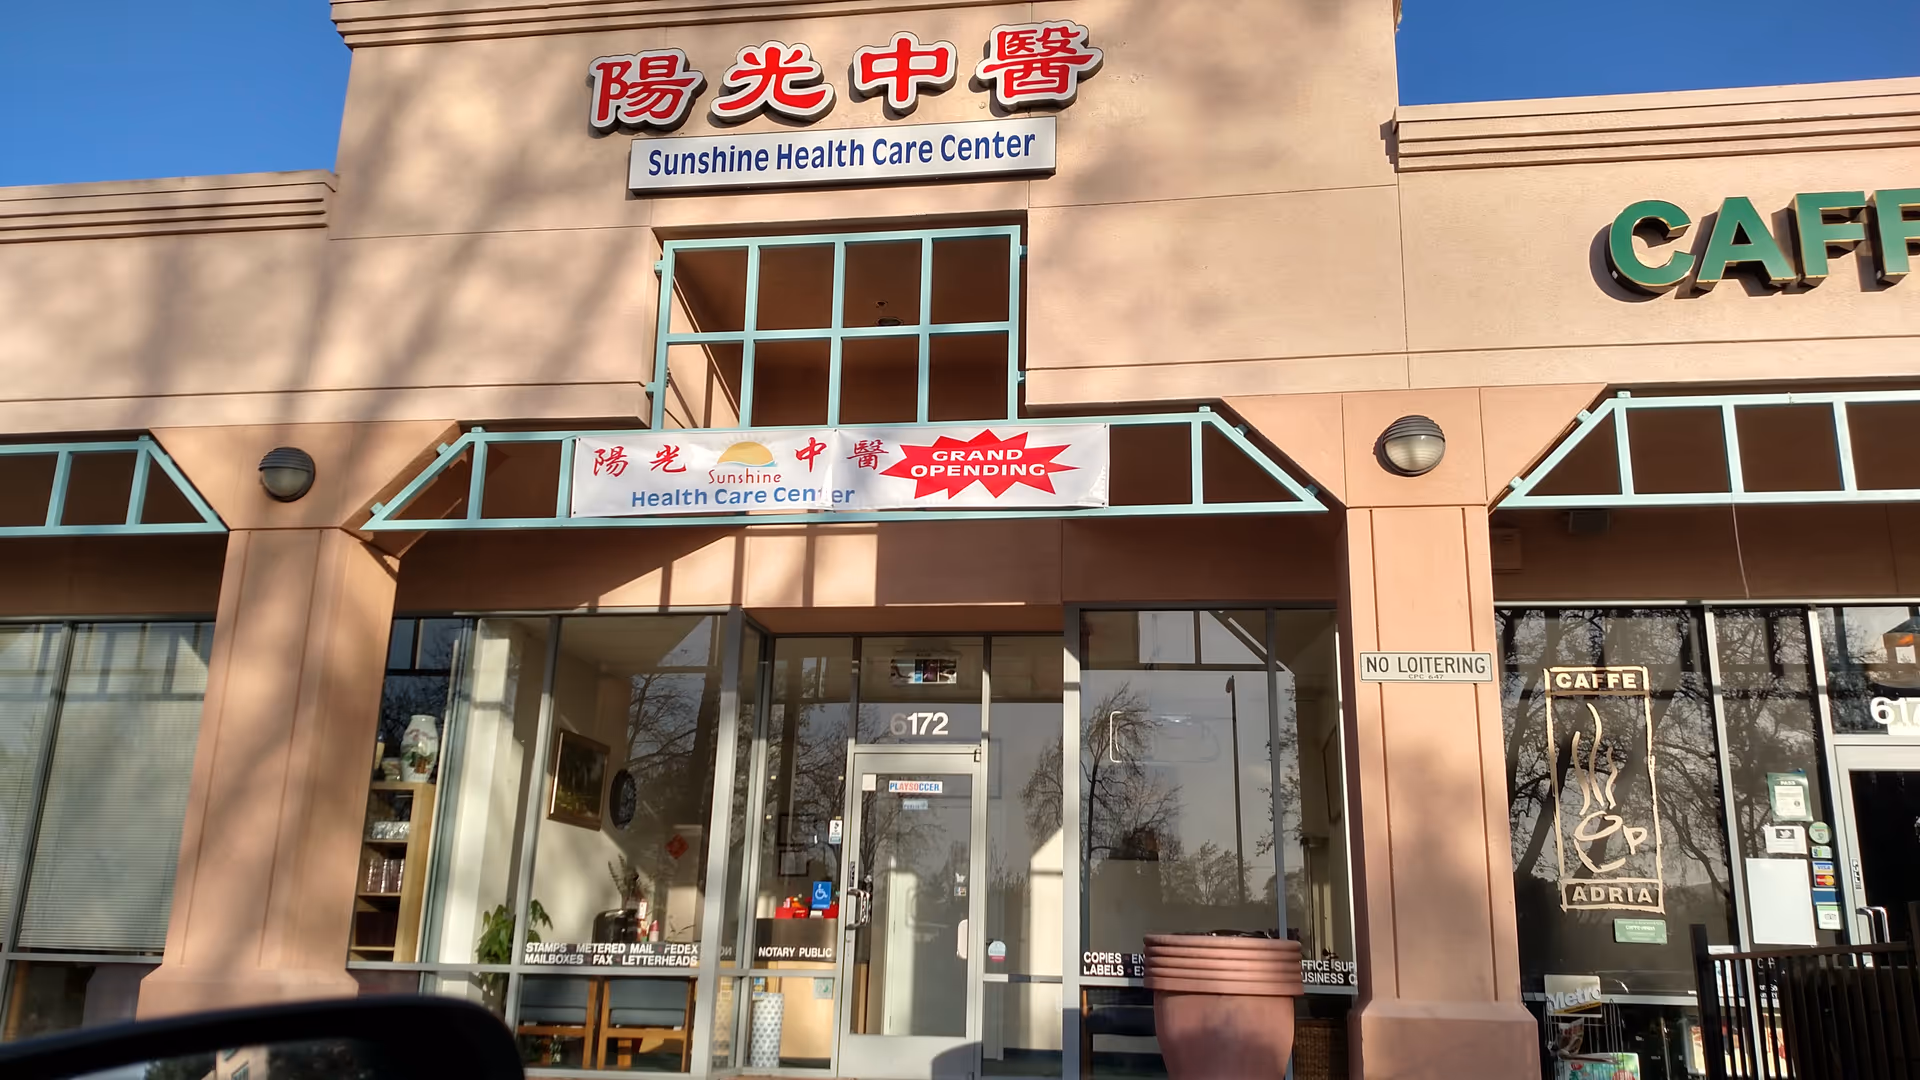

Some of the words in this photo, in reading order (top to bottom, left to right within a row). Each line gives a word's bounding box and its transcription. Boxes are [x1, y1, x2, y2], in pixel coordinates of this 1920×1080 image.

[648, 145, 769, 176] Sunshine
[776, 139, 864, 170] Health
[872, 138, 933, 166] Care
[940, 131, 1036, 162] Center
[932, 449, 1023, 461] GRAND
[708, 469, 782, 485] Sunshine
[910, 463, 1046, 478] OPENDING
[631, 488, 708, 508] Health
[714, 487, 767, 505] Care
[1366, 657, 1389, 673] NO
[1397, 657, 1486, 674] LOITERING
[1555, 672, 1637, 689] CAFFE
[890, 712, 949, 735] 6172
[889, 782, 940, 792] PLAYSOCCER
[1572, 886, 1653, 903] ADRIA
[525, 943, 567, 954] STAMPS
[576, 944, 626, 954] METERED
[630, 944, 654, 954] MAIL
[664, 945, 698, 954] FEDEX
[758, 947, 795, 957] NOTARY
[799, 947, 832, 957] PUBLIC
[524, 954, 584, 964] MAILBOXES
[592, 955, 613, 965] FAX
[622, 956, 698, 966] LETTERHEADS
[1083, 952, 1121, 964] COPIES
[1084, 965, 1124, 976] LABELS
[1300, 960, 1330, 971] FFICE
[1301, 972, 1344, 984] USINESS
[1546, 986, 1600, 1010] Metro
